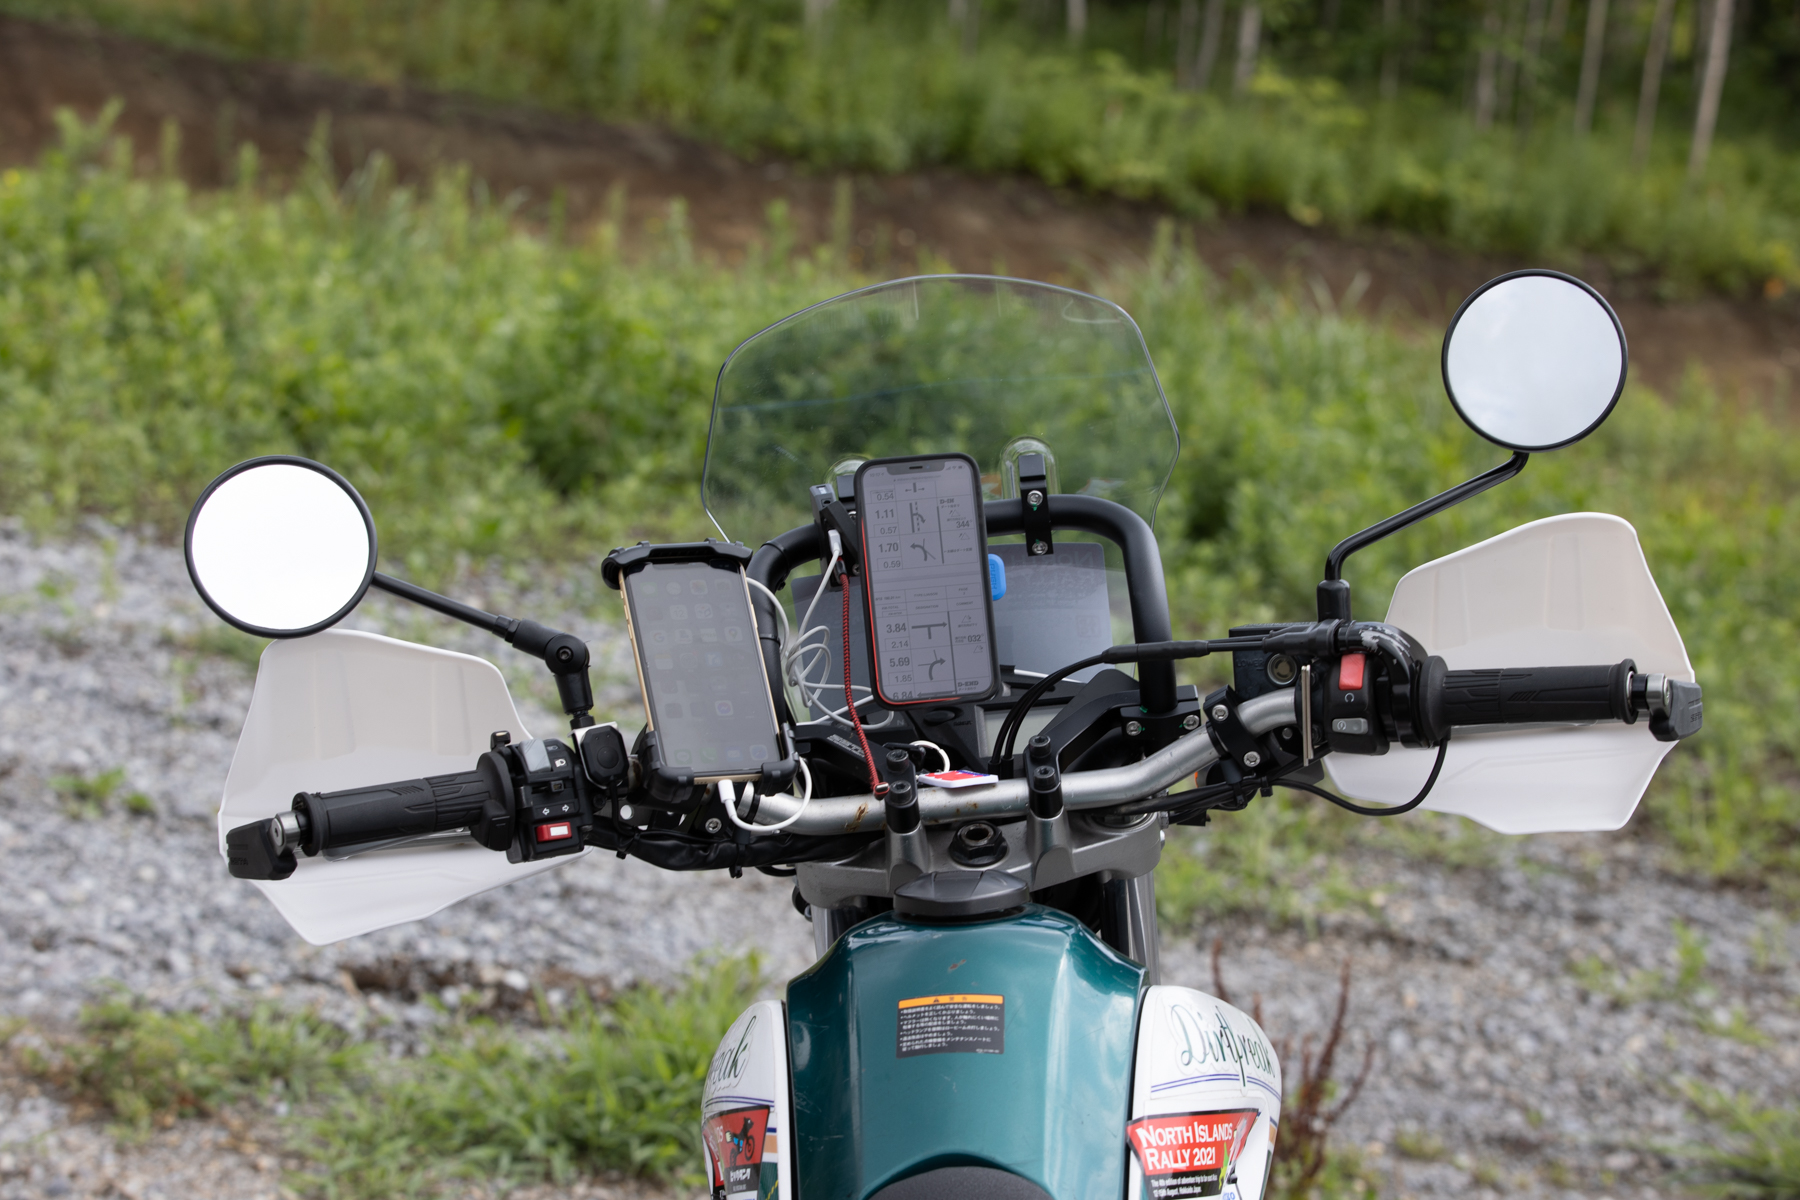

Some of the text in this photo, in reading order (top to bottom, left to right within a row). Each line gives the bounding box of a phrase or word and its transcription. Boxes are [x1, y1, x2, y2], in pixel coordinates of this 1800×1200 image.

[876, 492, 894, 501] 0.54
[874, 509, 895, 520] 1.11
[880, 526, 897, 535] 0.57
[878, 542, 899, 553] 1.70
[883, 561, 901, 569] 0.59
[886, 622, 907, 634] 3.84
[891, 640, 909, 649] 2.14
[889, 656, 911, 668] 5.69
[895, 674, 913, 683] 1.85
[893, 690, 913, 700] 6.84
[1135, 1121, 1233, 1148] NORTH ISLANDS
[1144, 1146, 1216, 1170] RALLY 2021
